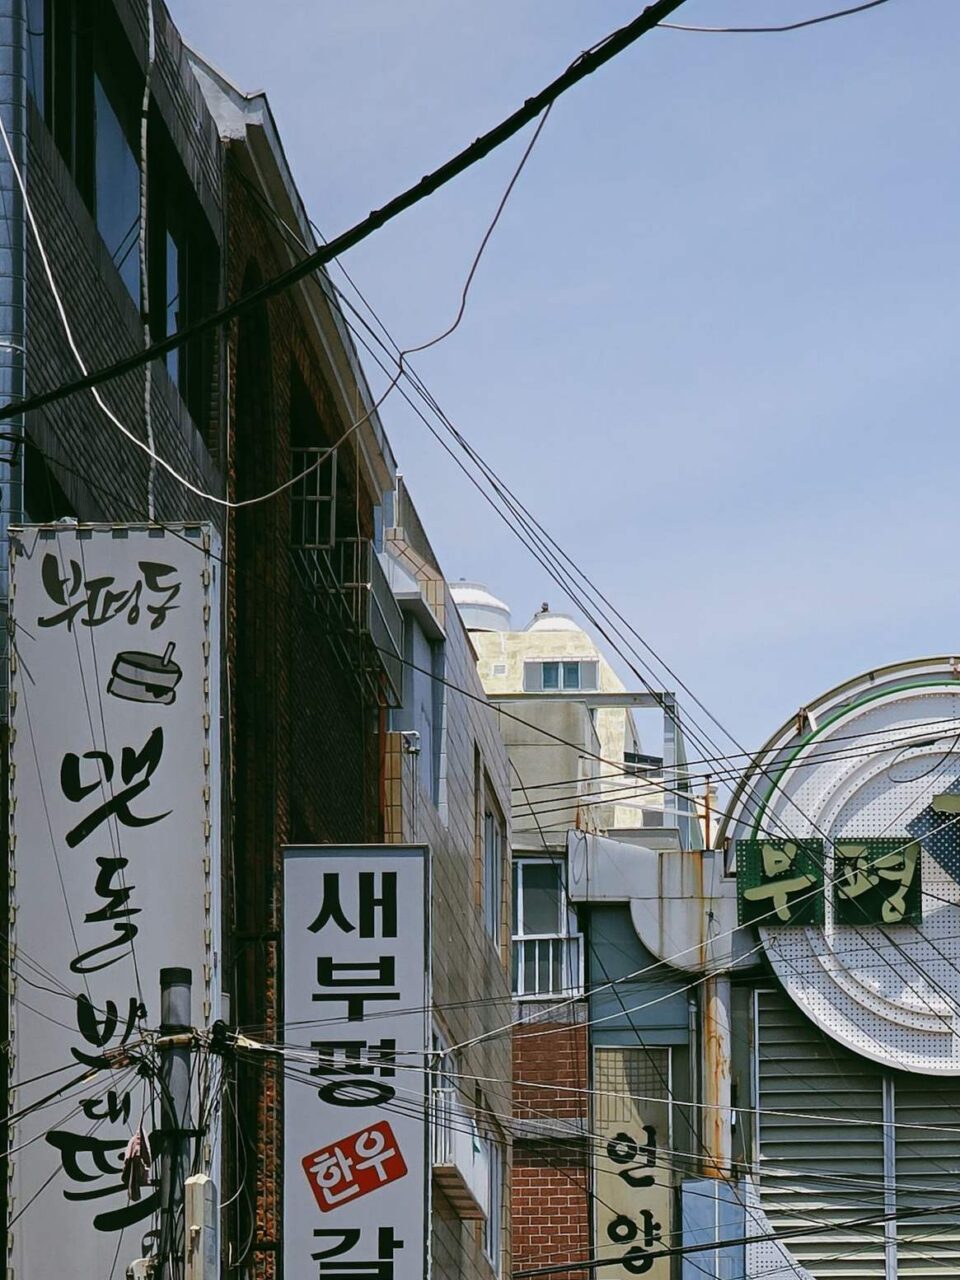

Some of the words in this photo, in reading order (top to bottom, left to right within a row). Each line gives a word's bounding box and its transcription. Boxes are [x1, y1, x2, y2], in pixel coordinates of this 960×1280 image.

[306, 871, 400, 1107] 새부평
[310, 1130, 396, 1204] 한우
[606, 1125, 662, 1274] 언양
